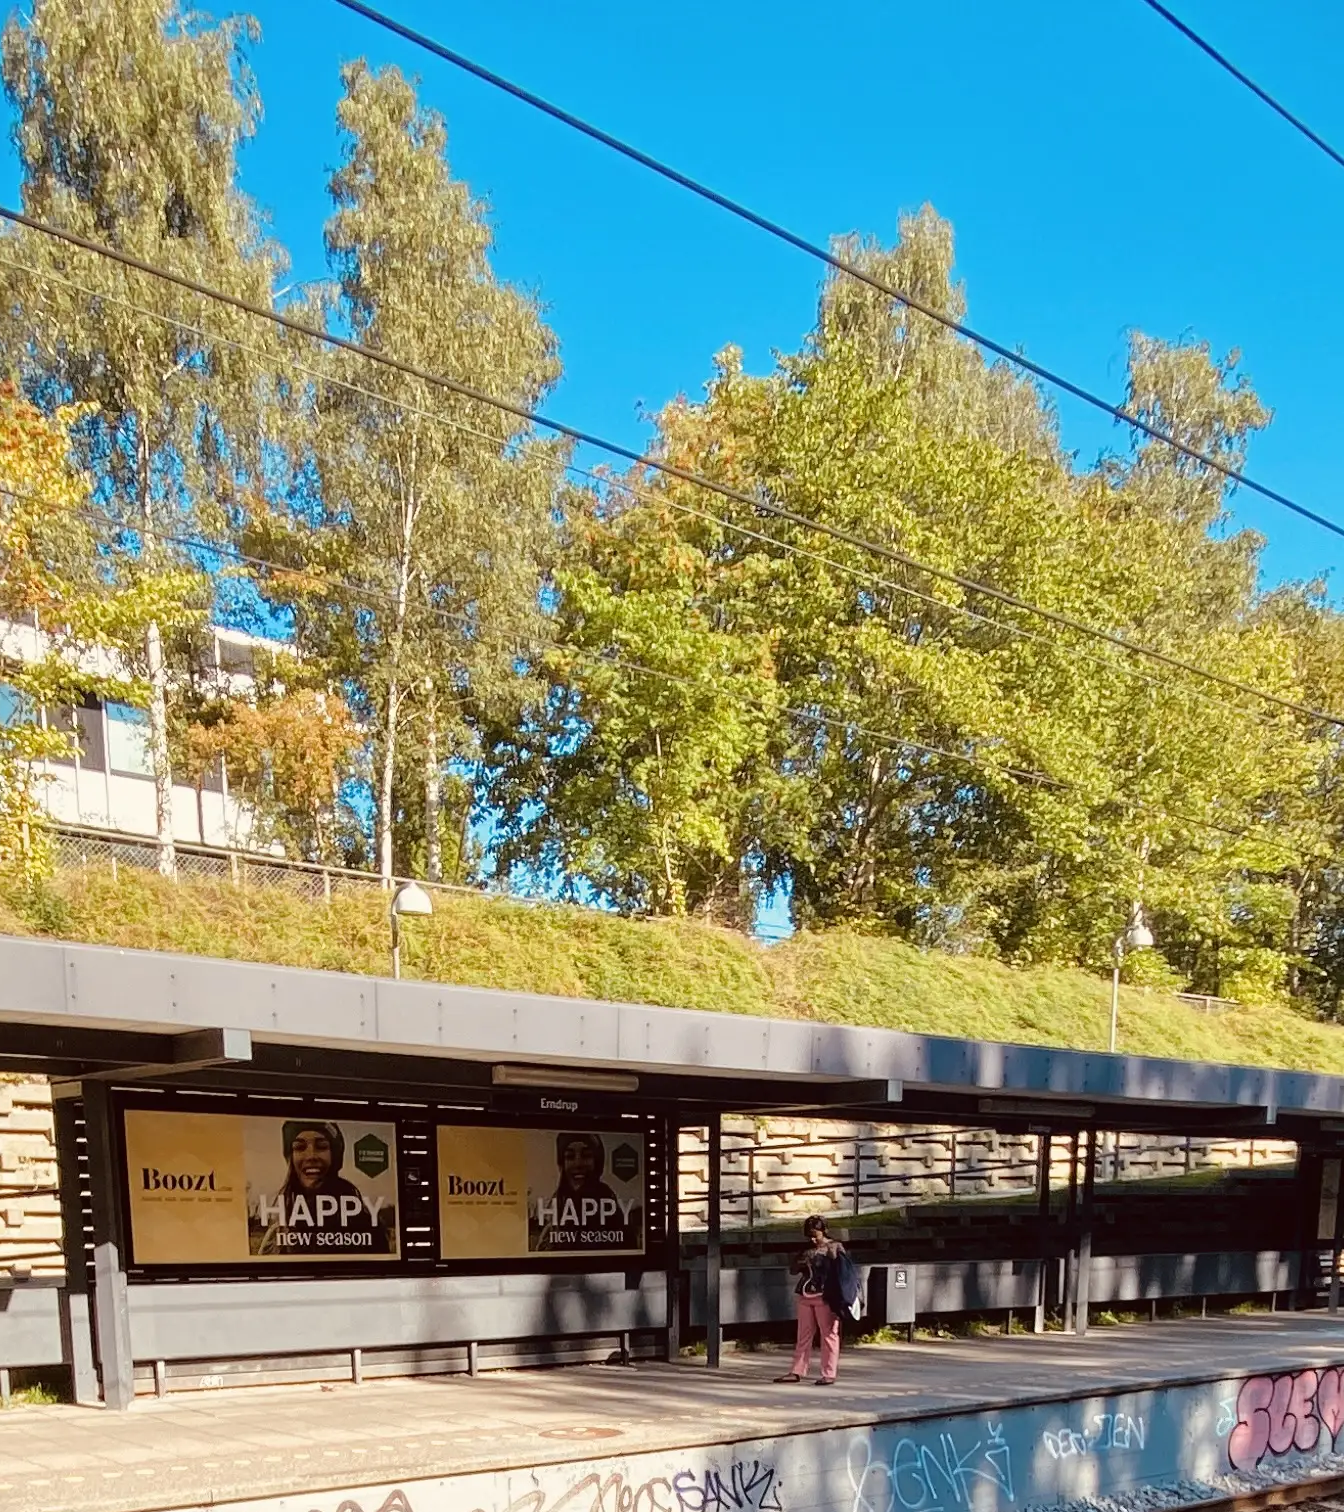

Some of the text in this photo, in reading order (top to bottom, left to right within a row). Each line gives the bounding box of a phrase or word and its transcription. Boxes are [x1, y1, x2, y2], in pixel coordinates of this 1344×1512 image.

[540, 1097, 578, 1113] Emdrup
[142, 1167, 217, 1191] Boozt
[448, 1175, 504, 1196] Boozt
[259, 1194, 384, 1227] HAPPY
[537, 1197, 635, 1226] HAPPY
[276, 1231, 372, 1246] new season
[549, 1230, 624, 1243] new season
